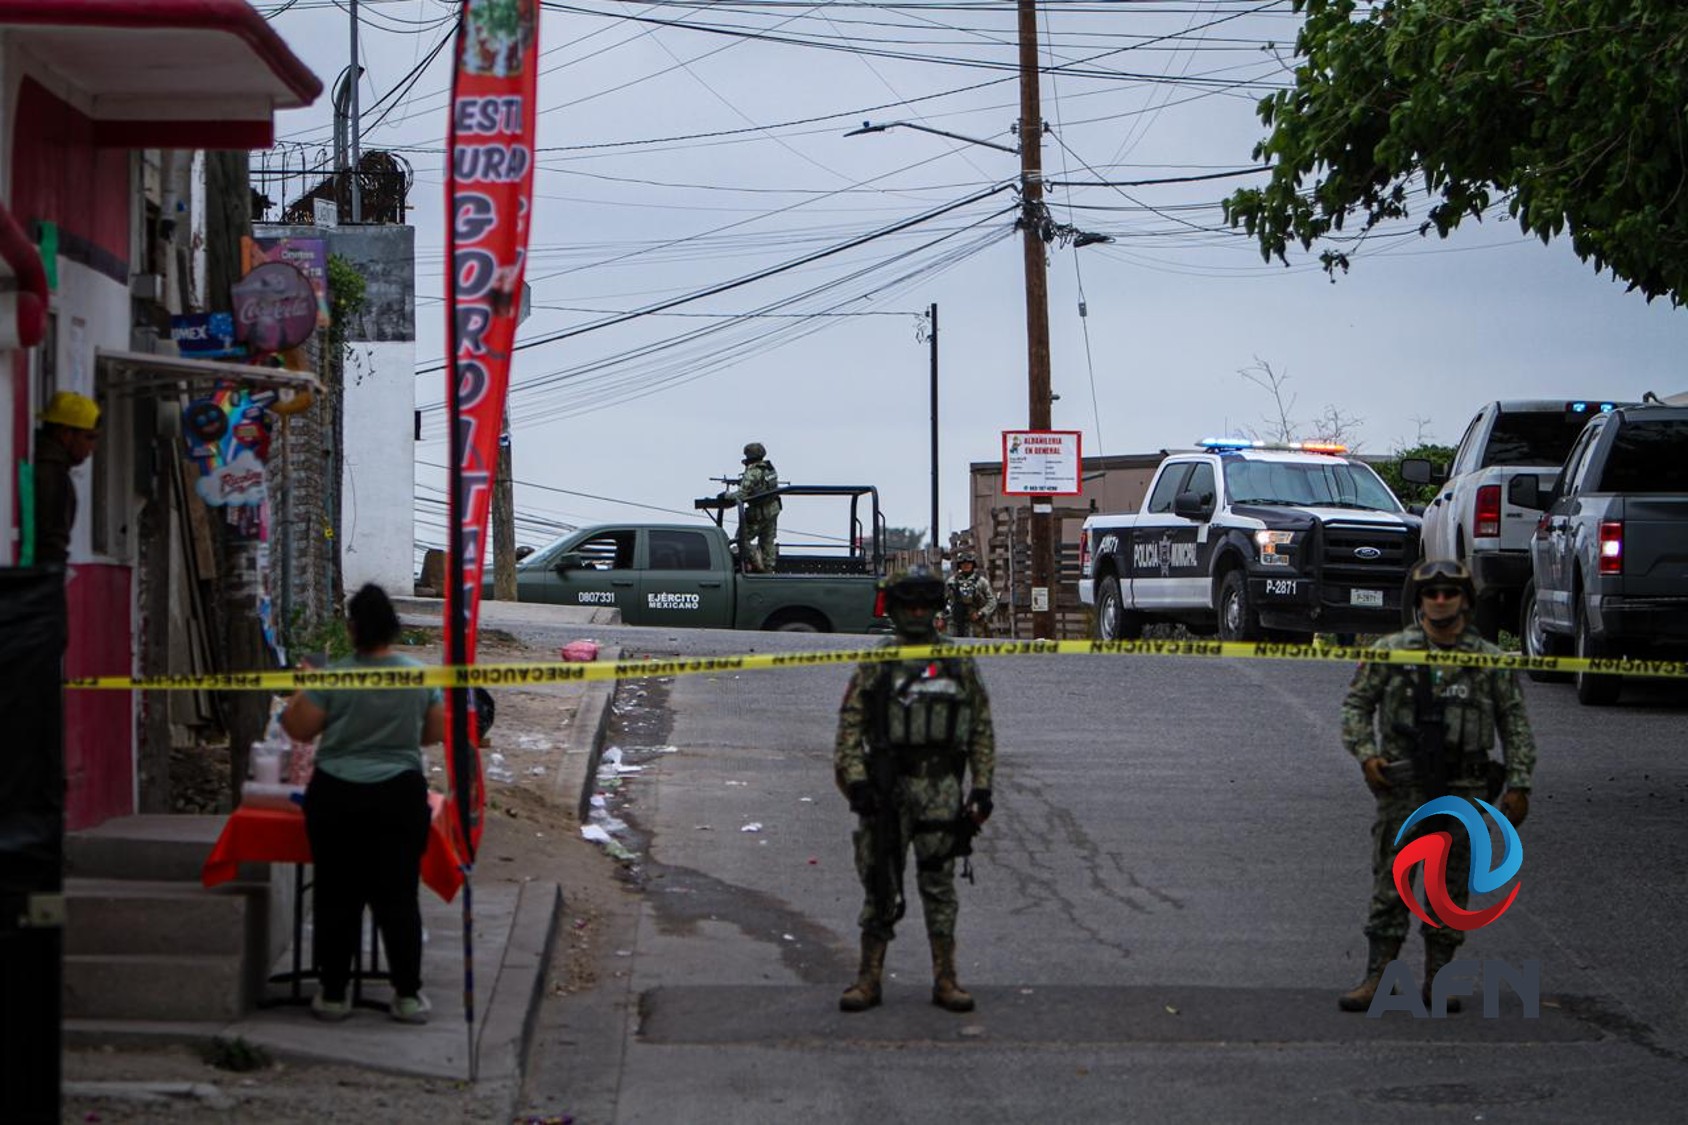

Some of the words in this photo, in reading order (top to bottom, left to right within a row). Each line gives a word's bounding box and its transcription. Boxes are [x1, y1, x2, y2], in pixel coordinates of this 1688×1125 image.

[454, 193, 497, 632] GORDITA
[1266, 579, 1297, 596] P-2871
[578, 592, 615, 603] 0807331
[648, 592, 699, 603] EJÉRCITO
